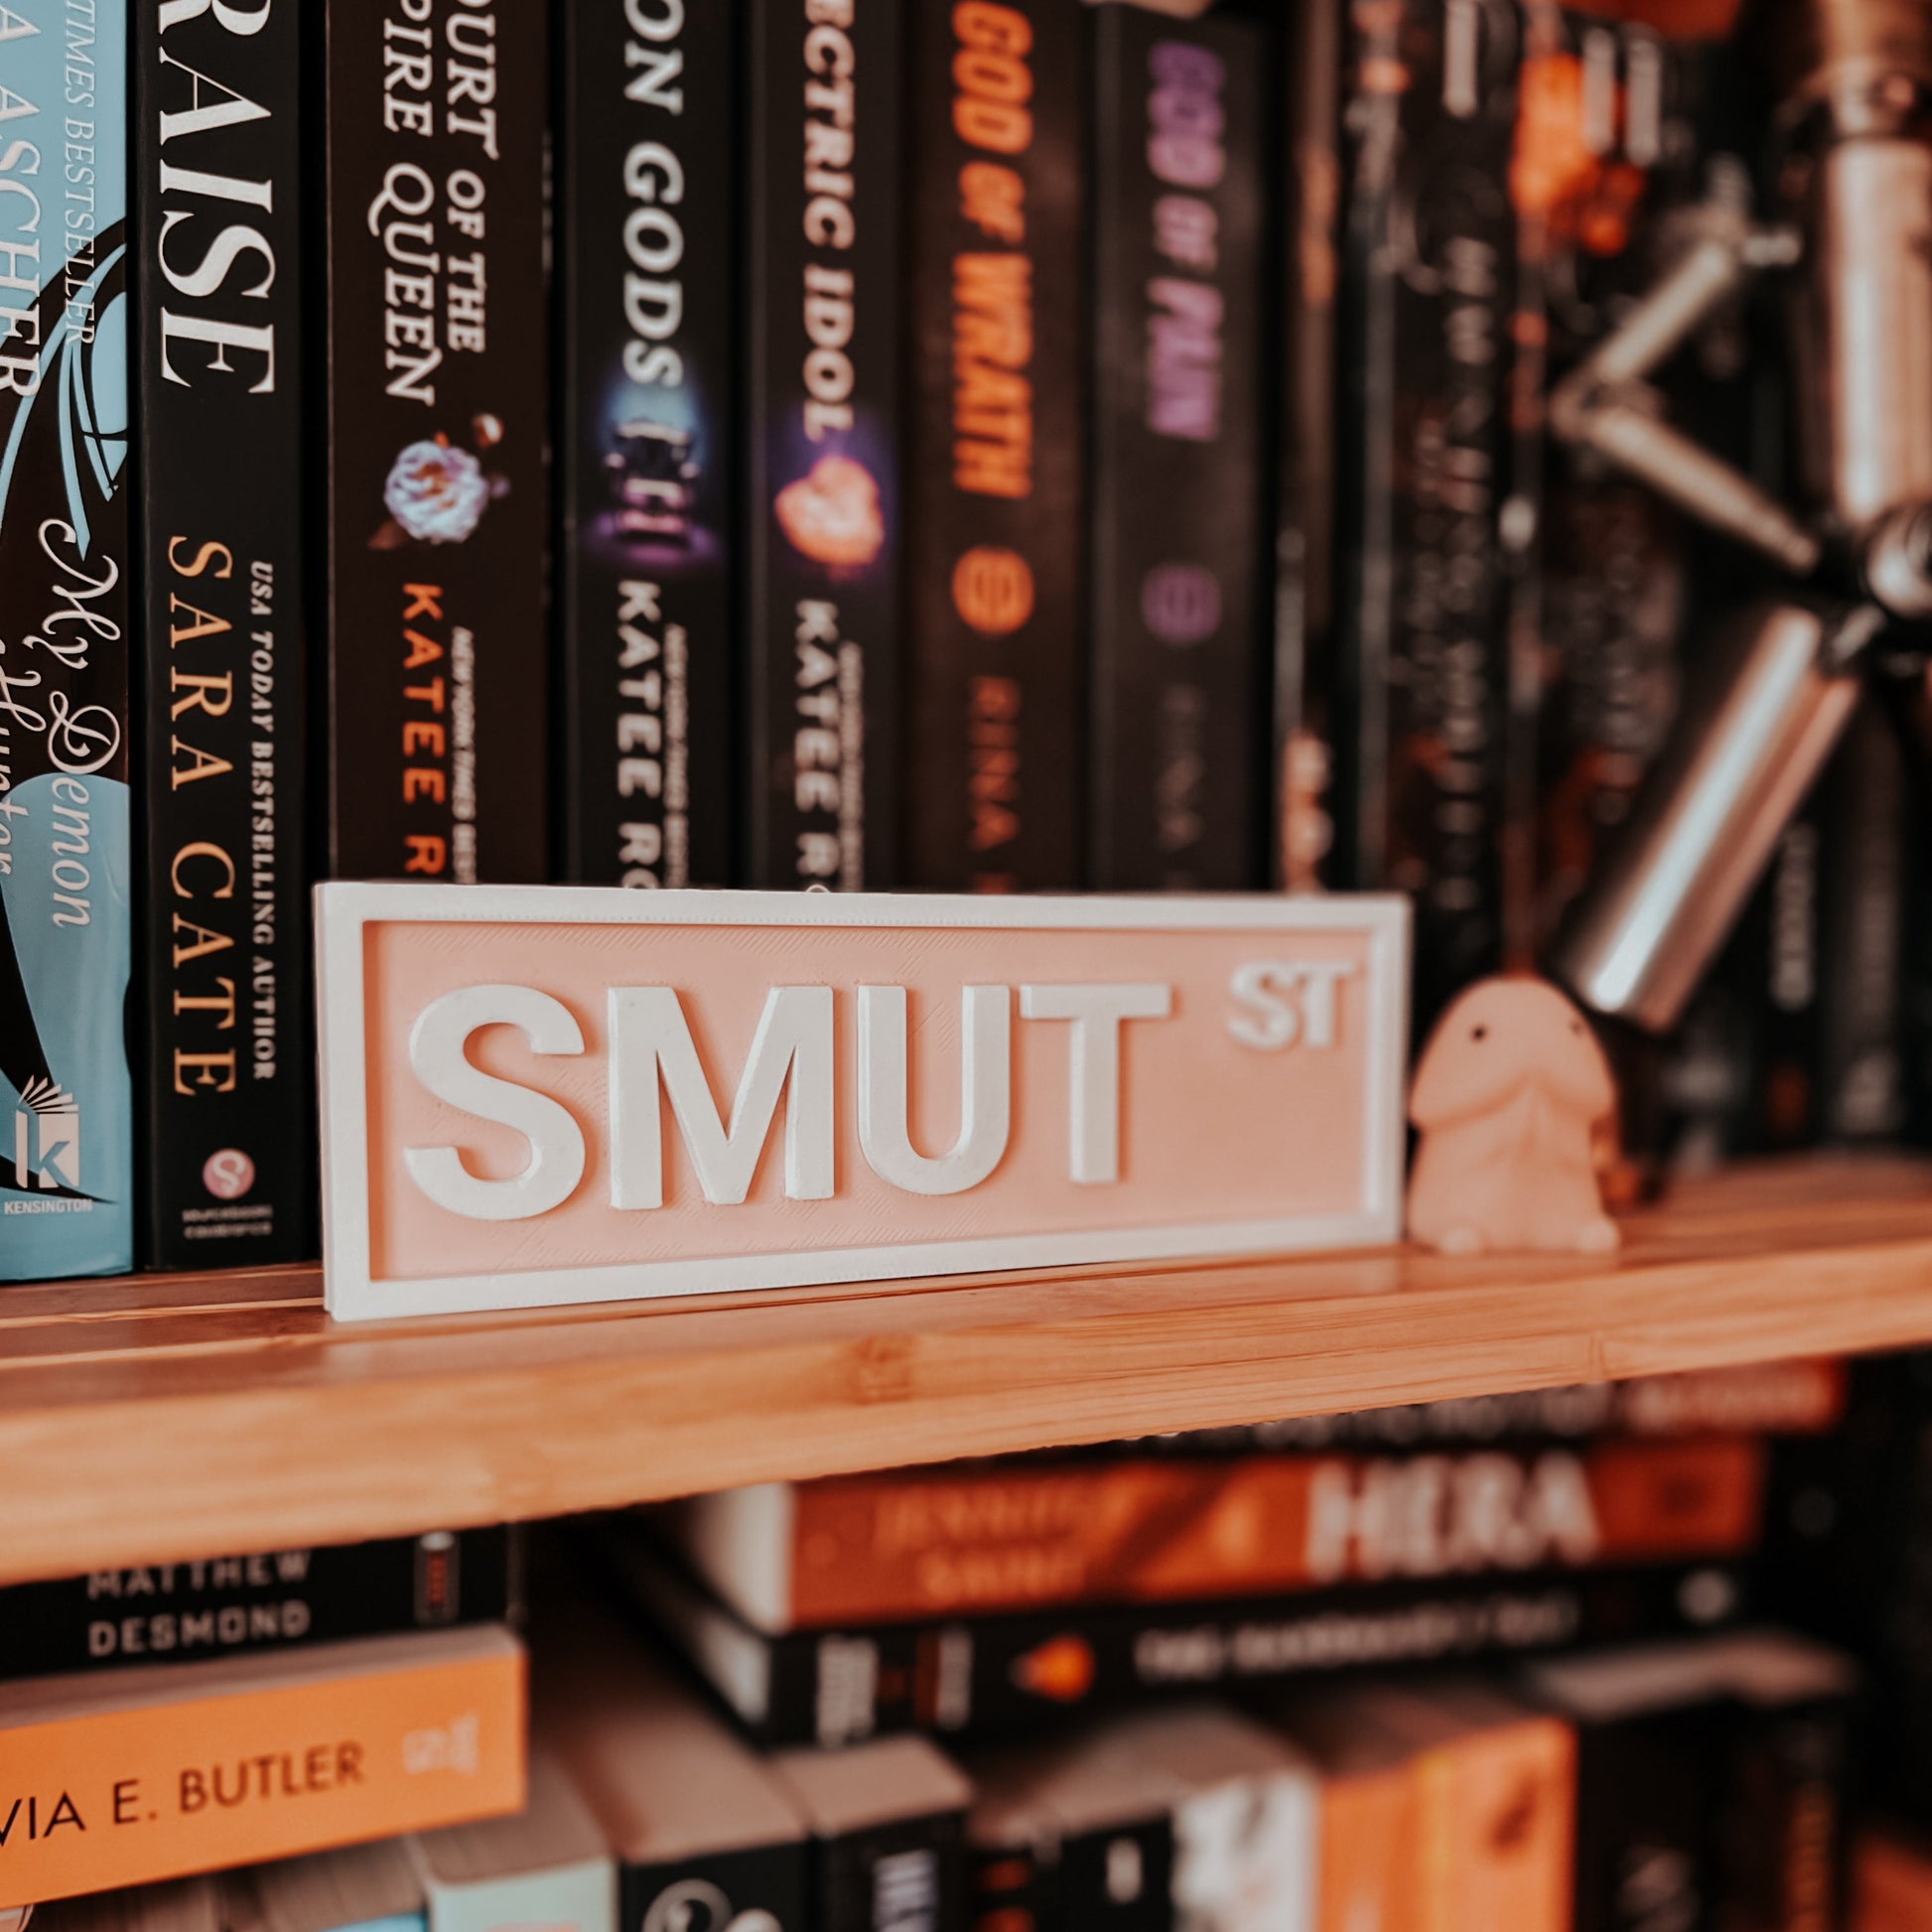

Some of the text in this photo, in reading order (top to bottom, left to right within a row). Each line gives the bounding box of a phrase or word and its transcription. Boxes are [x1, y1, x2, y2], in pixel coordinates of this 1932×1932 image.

[446, 0, 499, 353] URT OF THE
[952, 0, 1034, 155] GOD
[66, 120, 95, 346] BESTSELLER
[368, 162, 443, 407] QUEEN
[622, 141, 684, 386] GODS
[802, 263, 856, 442] IDOL
[952, 252, 1034, 498] WRATH
[402, 583, 446, 803] KATEE
[618, 580, 662, 797] KATEE
[794, 599, 841, 811] KATEE
[48, 691, 121, 928] Demon
[168, 535, 236, 1096] SARA CATE
[250, 560, 276, 1079] USA TODAY BESTSELLING AUTHOR
[405, 959, 1357, 1221] SMUT ST
[4, 1198, 94, 1215] KENSINGTON
[88, 1599, 312, 1657] DESMOND
[112, 1779, 158, 1826] E.
[179, 1739, 366, 1815] BUTLER
